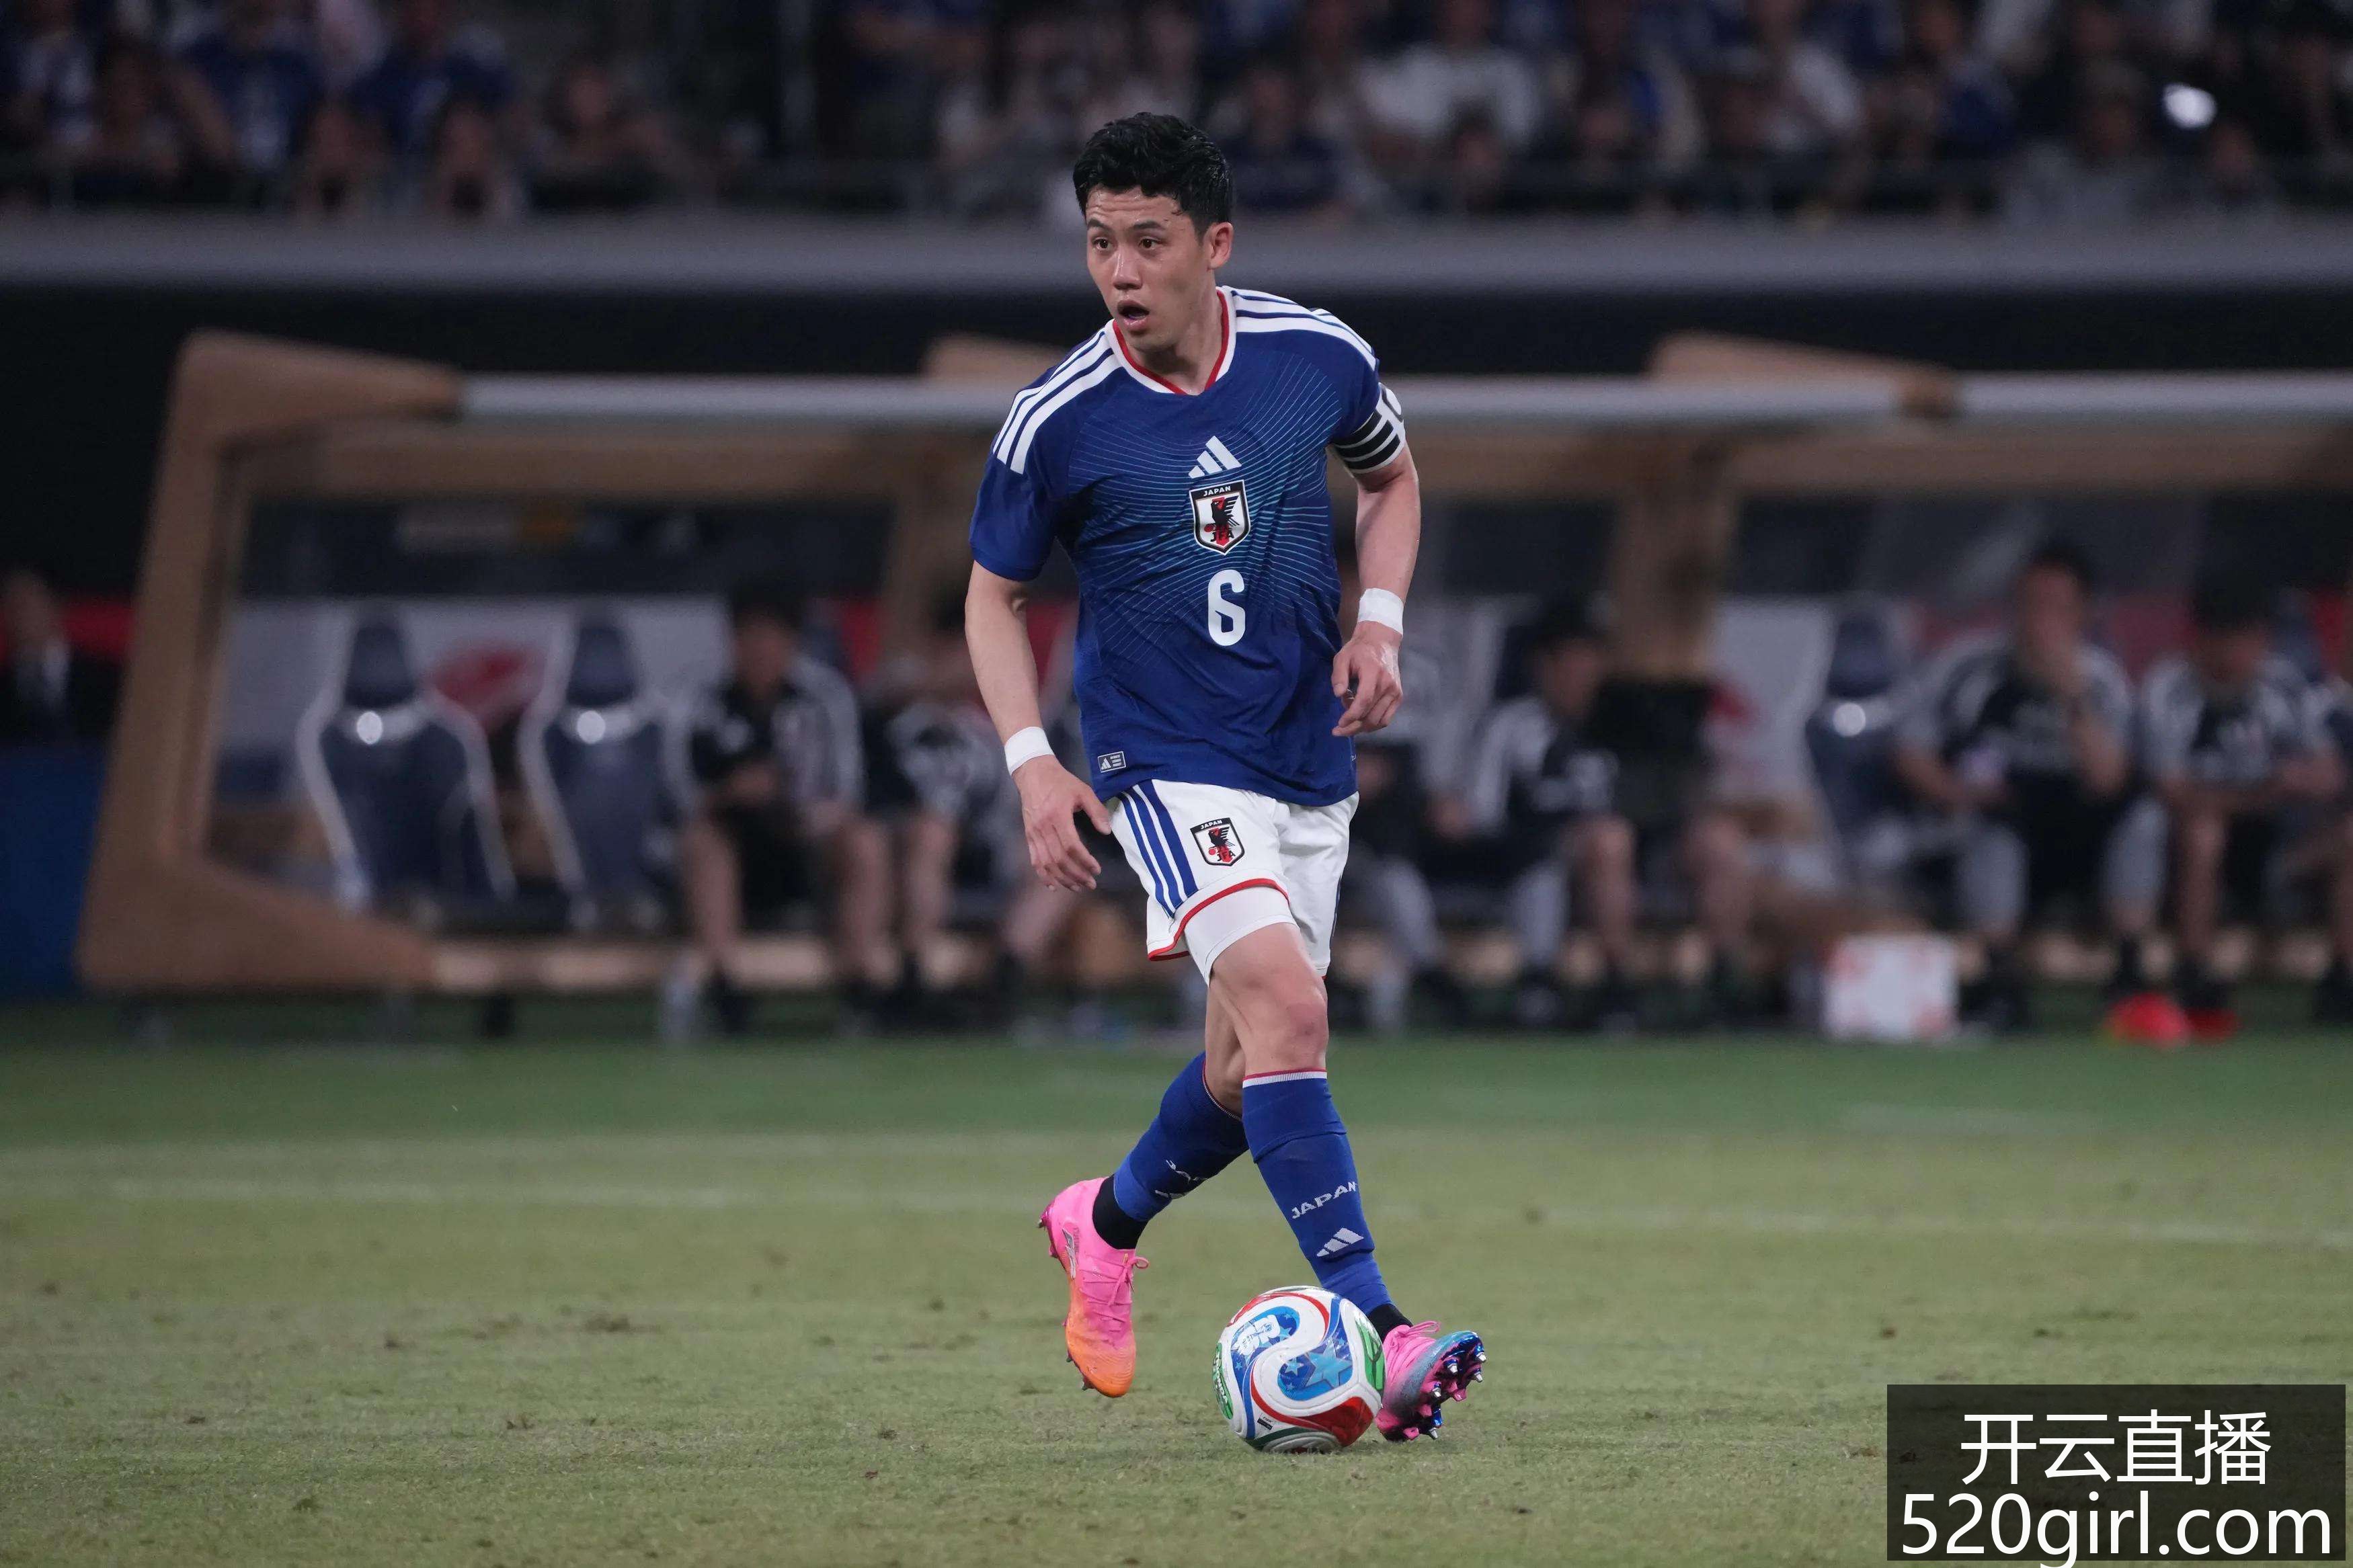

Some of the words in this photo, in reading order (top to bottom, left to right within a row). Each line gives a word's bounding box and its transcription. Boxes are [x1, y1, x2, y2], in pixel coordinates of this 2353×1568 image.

[1203, 486, 1232, 497] JAPAN
[1207, 569, 1245, 646] 6
[1200, 819, 1223, 830] JAPAN
[1291, 1181, 1357, 1219] JAPAN
